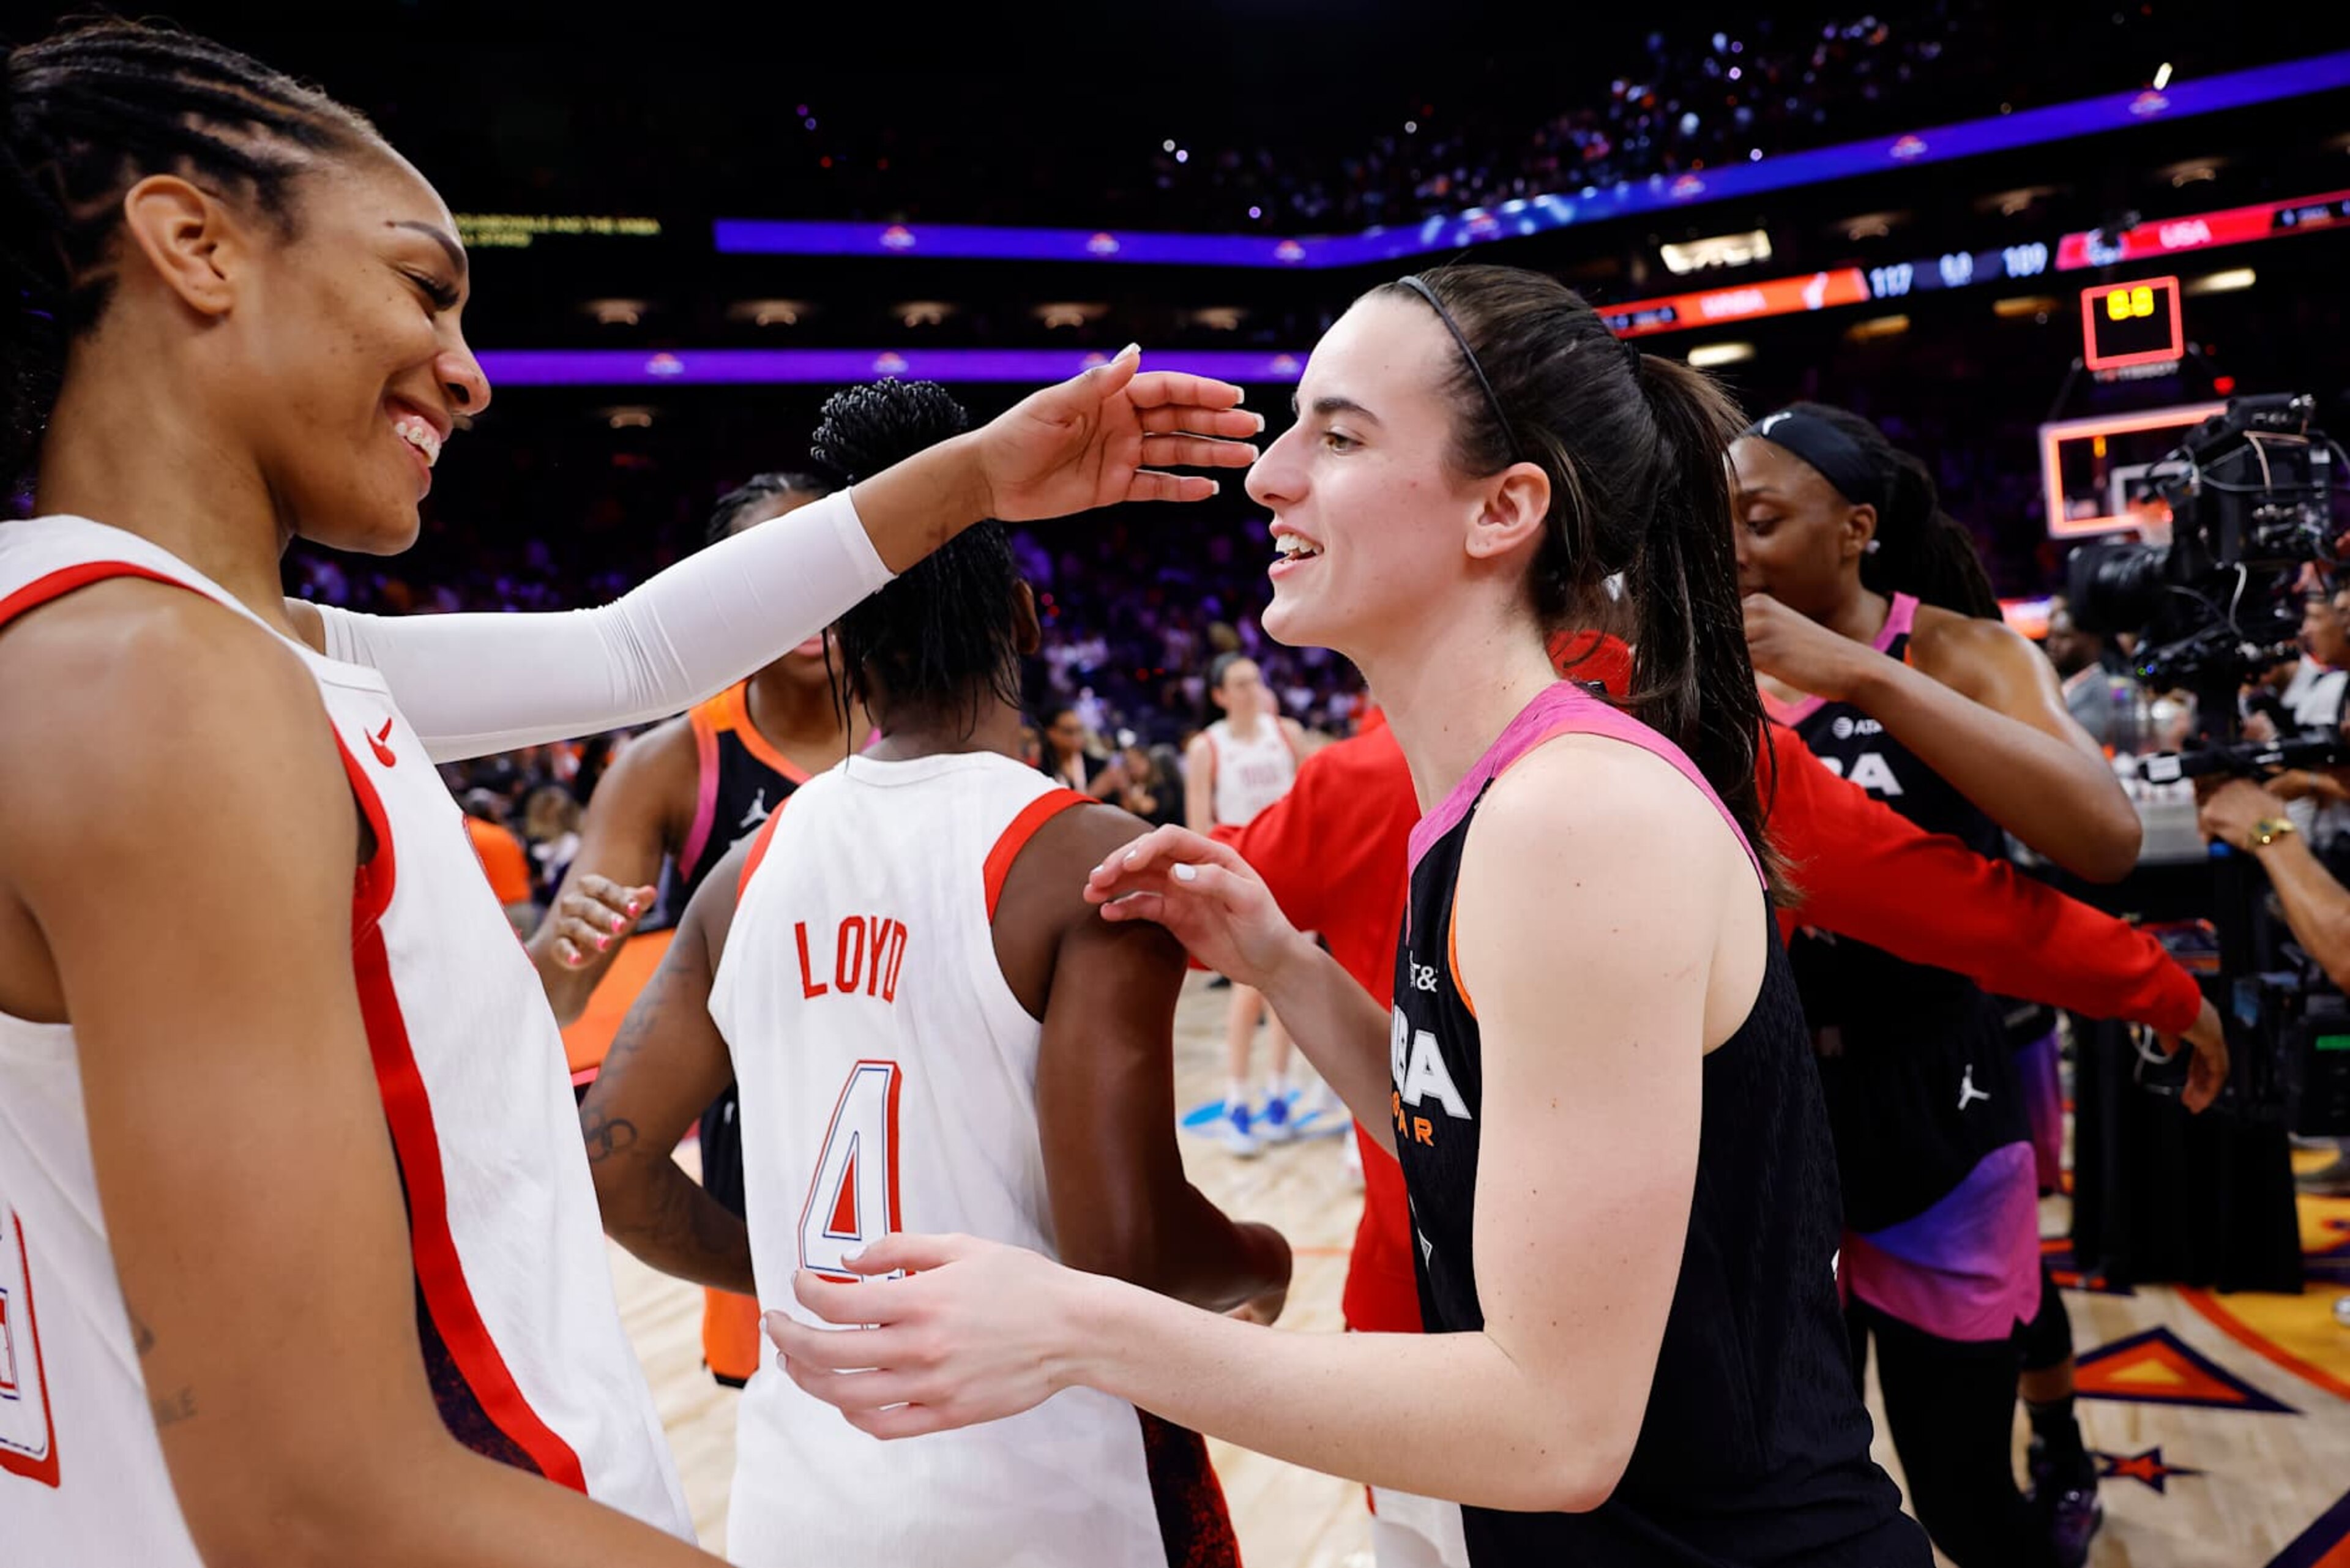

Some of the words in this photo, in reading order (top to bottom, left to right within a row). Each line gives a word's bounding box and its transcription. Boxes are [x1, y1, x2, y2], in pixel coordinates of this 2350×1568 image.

[1869, 263, 1914, 298] 117
[2002, 242, 2048, 278] 109
[794, 914, 908, 1004] LOYD
[797, 1059, 908, 1291] 4
